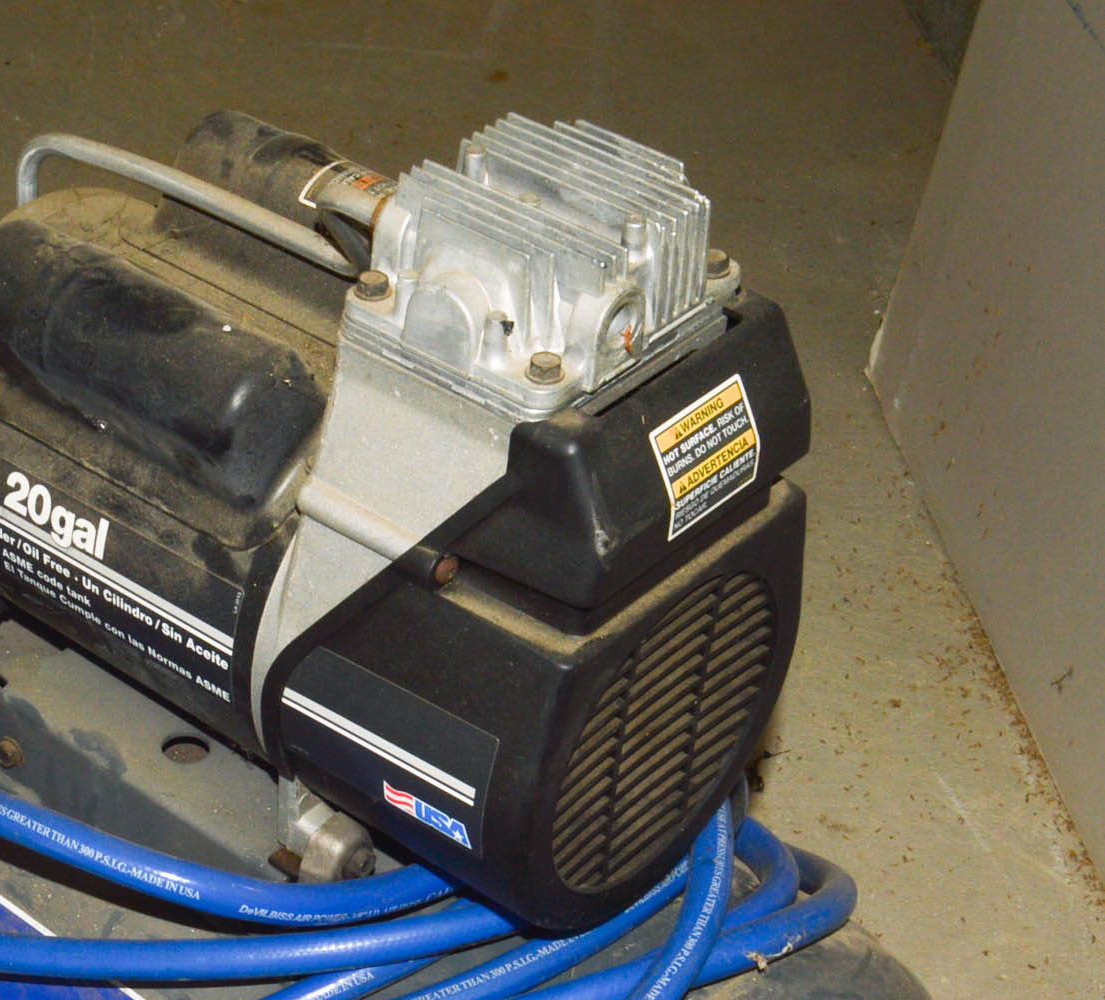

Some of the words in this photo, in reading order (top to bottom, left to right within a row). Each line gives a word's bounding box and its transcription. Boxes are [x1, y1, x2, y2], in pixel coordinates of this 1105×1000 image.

[662, 447, 680, 465] HOT
[733, 402, 744, 416] OF
[679, 396, 724, 432] WARNING
[686, 436, 748, 487] ADVERTENCIA
[694, 443, 707, 458] DO
[705, 433, 722, 449] NOT
[7, 474, 110, 560] 20gal
[4, 548, 32, 573] ASME
[39, 568, 60, 591] code
[67, 585, 89, 607] tank
[5, 560, 13, 574] El
[19, 569, 54, 599] Tanque
[62, 594, 99, 625] Cumple
[106, 621, 123, 639] con
[129, 633, 143, 651] las
[149, 646, 190, 680] Normas
[197, 674, 228, 703] ASME
[45, 553, 68, 579] Free
[83, 575, 97, 595] Un
[189, 636, 226, 671] Aceite
[408, 799, 477, 845] USA
[3, 809, 52, 837] GREATER
[49, 830, 80, 850] THAN
[77, 843, 96, 859] 300
[163, 879, 178, 892] IN
[176, 884, 201, 900] USA
[238, 901, 294, 923] DeVILBISS
[700, 875, 722, 915] GREATER
[690, 912, 709, 939] THAN
[350, 970, 376, 988] USA
[461, 971, 490, 990] THAN
[489, 965, 507, 981] 300
